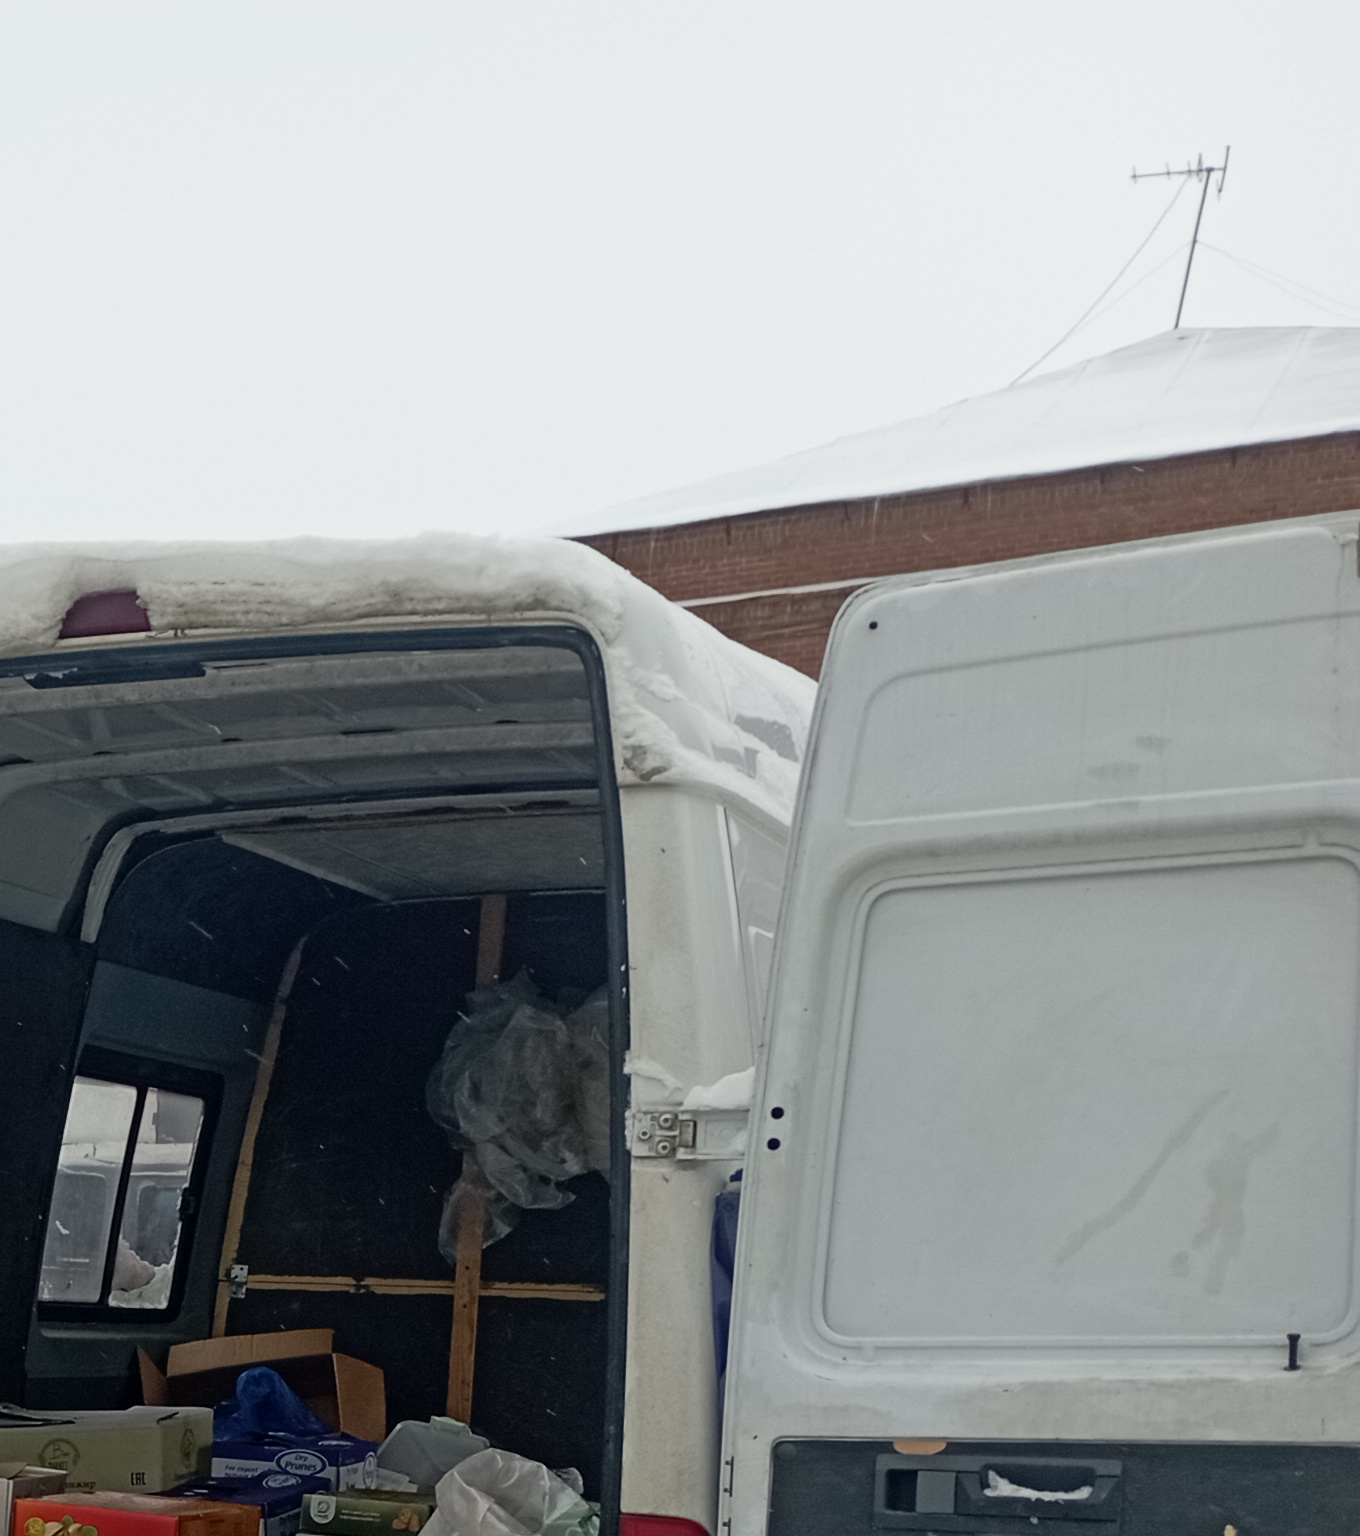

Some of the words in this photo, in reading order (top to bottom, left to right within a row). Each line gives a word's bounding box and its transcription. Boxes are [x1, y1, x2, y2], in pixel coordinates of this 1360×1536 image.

[294, 1454, 309, 1462] Dry
[284, 1460, 318, 1472] Prunes
[66, 1480, 96, 1490] нжир
